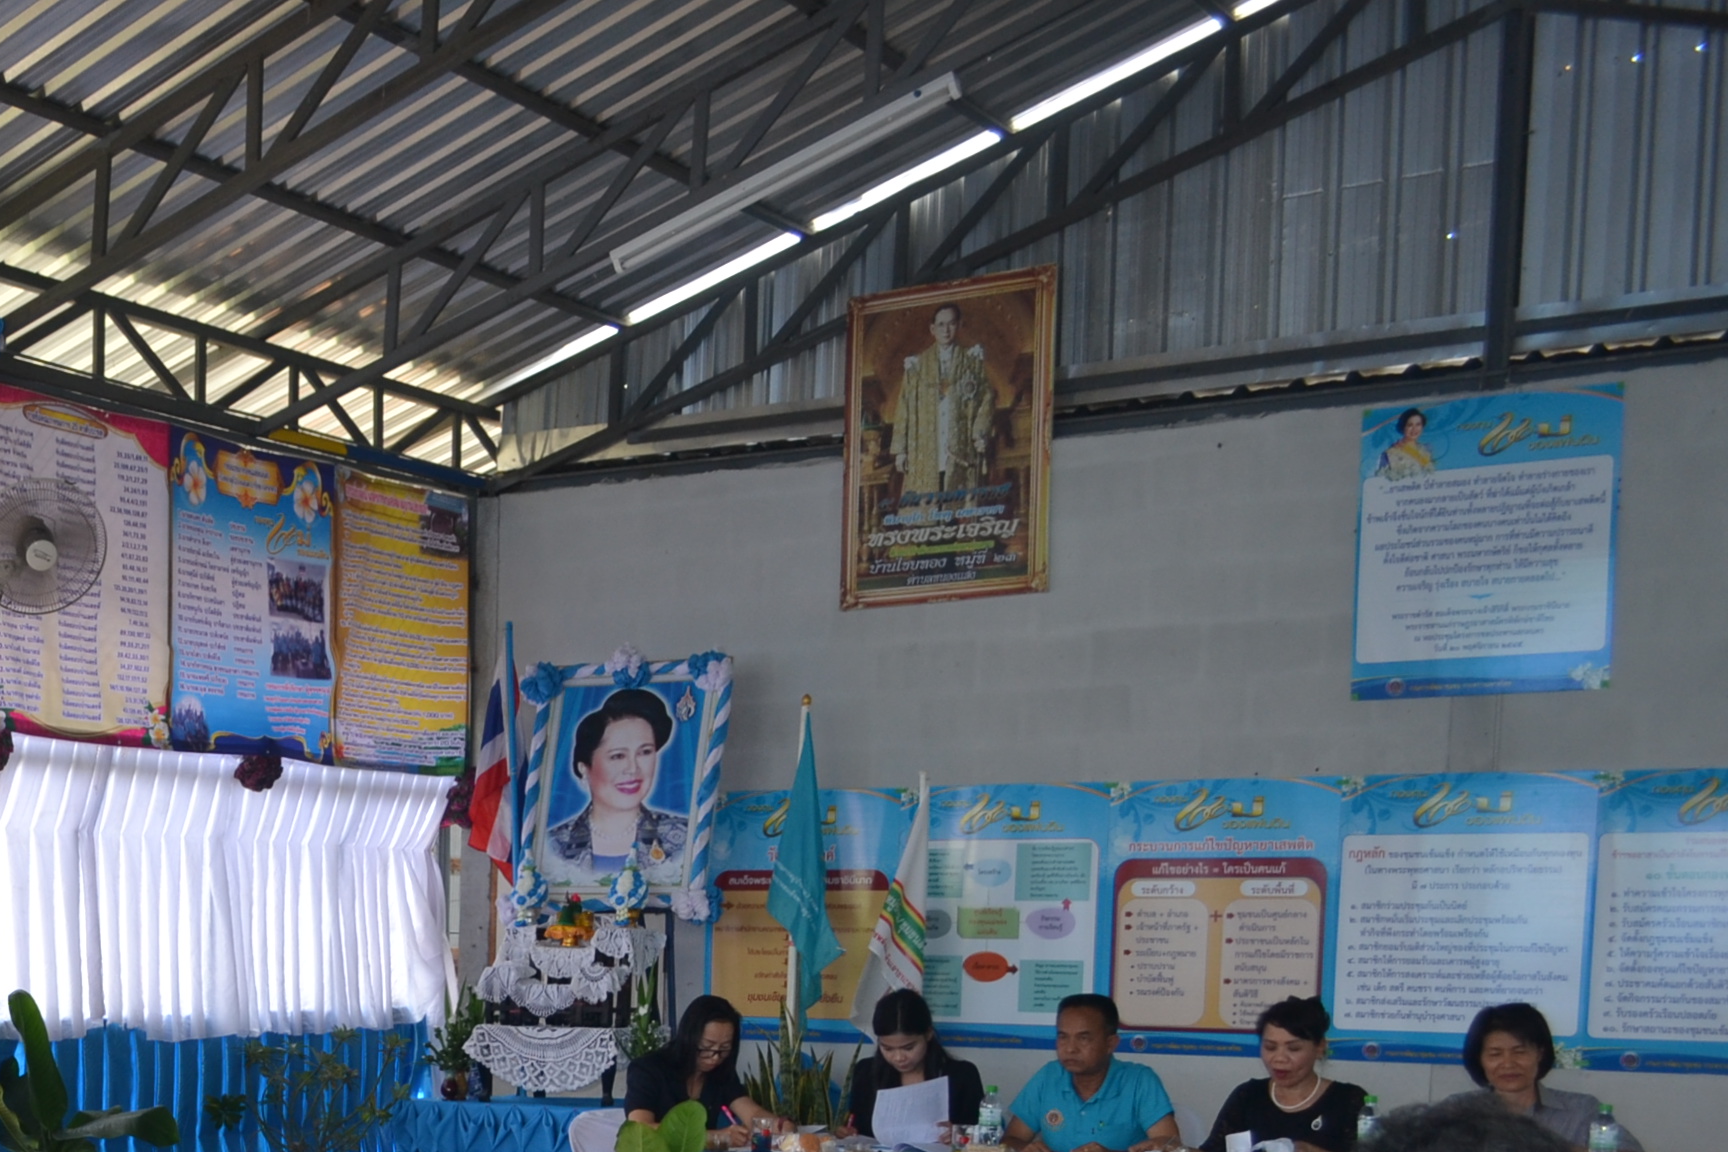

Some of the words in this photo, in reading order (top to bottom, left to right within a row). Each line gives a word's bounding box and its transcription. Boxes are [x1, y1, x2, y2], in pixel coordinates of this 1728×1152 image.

[868, 516, 1020, 548] ทรงพระเจริญ
[1348, 846, 1385, 863] กฎหลัก
